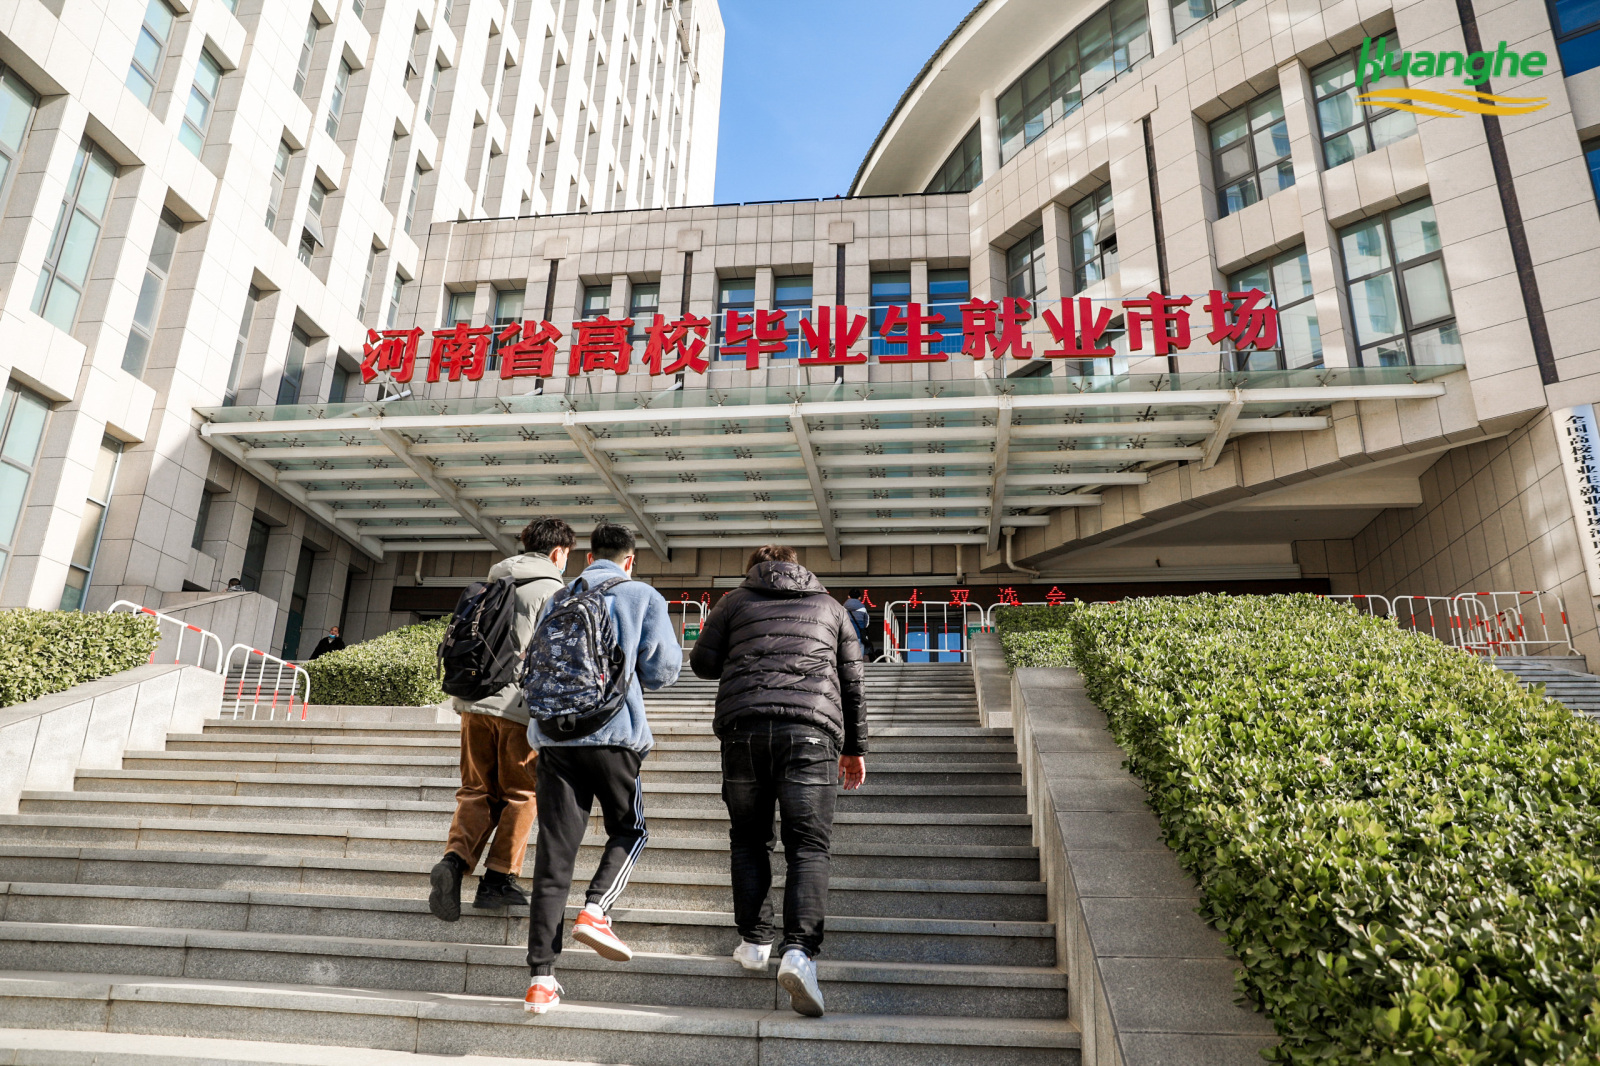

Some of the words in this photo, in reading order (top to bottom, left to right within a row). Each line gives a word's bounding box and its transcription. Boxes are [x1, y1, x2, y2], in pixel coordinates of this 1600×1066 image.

[360, 288, 1278, 384] 河南省高校毕业生就业市场
[1564, 415, 1600, 580] 全国高校毕业生就业市场
